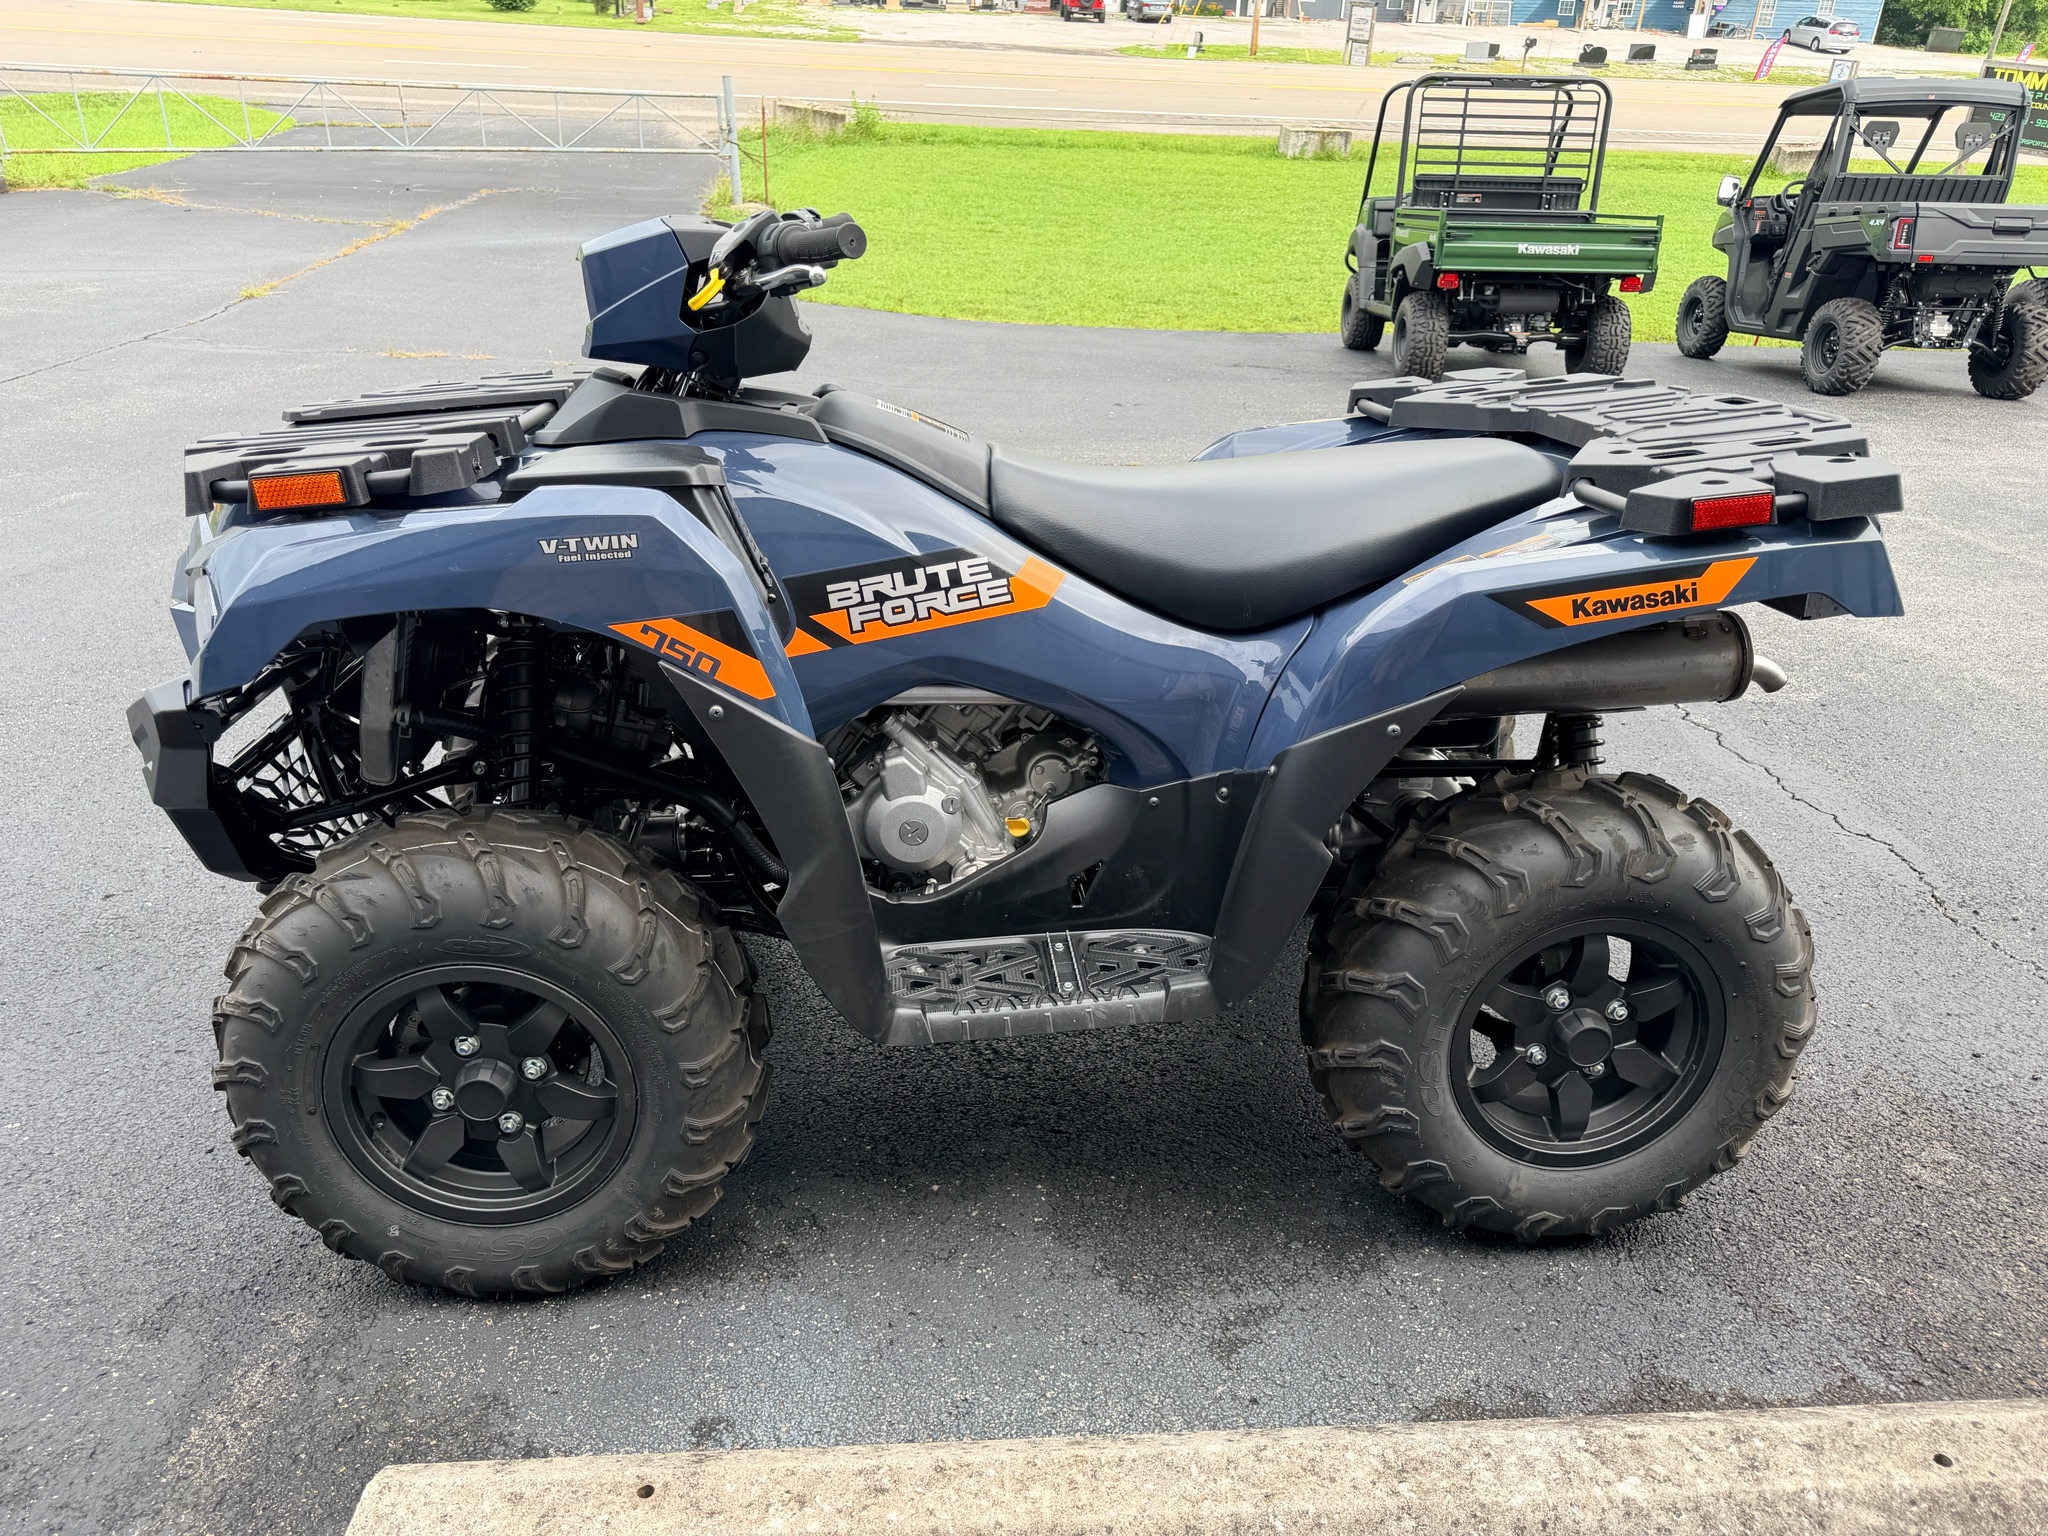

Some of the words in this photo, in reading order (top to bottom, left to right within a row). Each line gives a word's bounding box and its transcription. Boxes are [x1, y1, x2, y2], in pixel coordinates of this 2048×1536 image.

[1990, 111, 2006, 122] 423
[1517, 243, 1580, 256] Kawasaki
[538, 533, 639, 555] V-TWIN
[557, 554, 581, 563] Fuel
[585, 550, 632, 561] Injected
[826, 556, 993, 609] BRUTE
[848, 578, 1011, 631] FORCE
[1571, 582, 1698, 620] Kawasaki
[640, 624, 722, 679] 750
[1418, 1013, 1448, 1117] CST
[446, 1227, 564, 1262] CST
